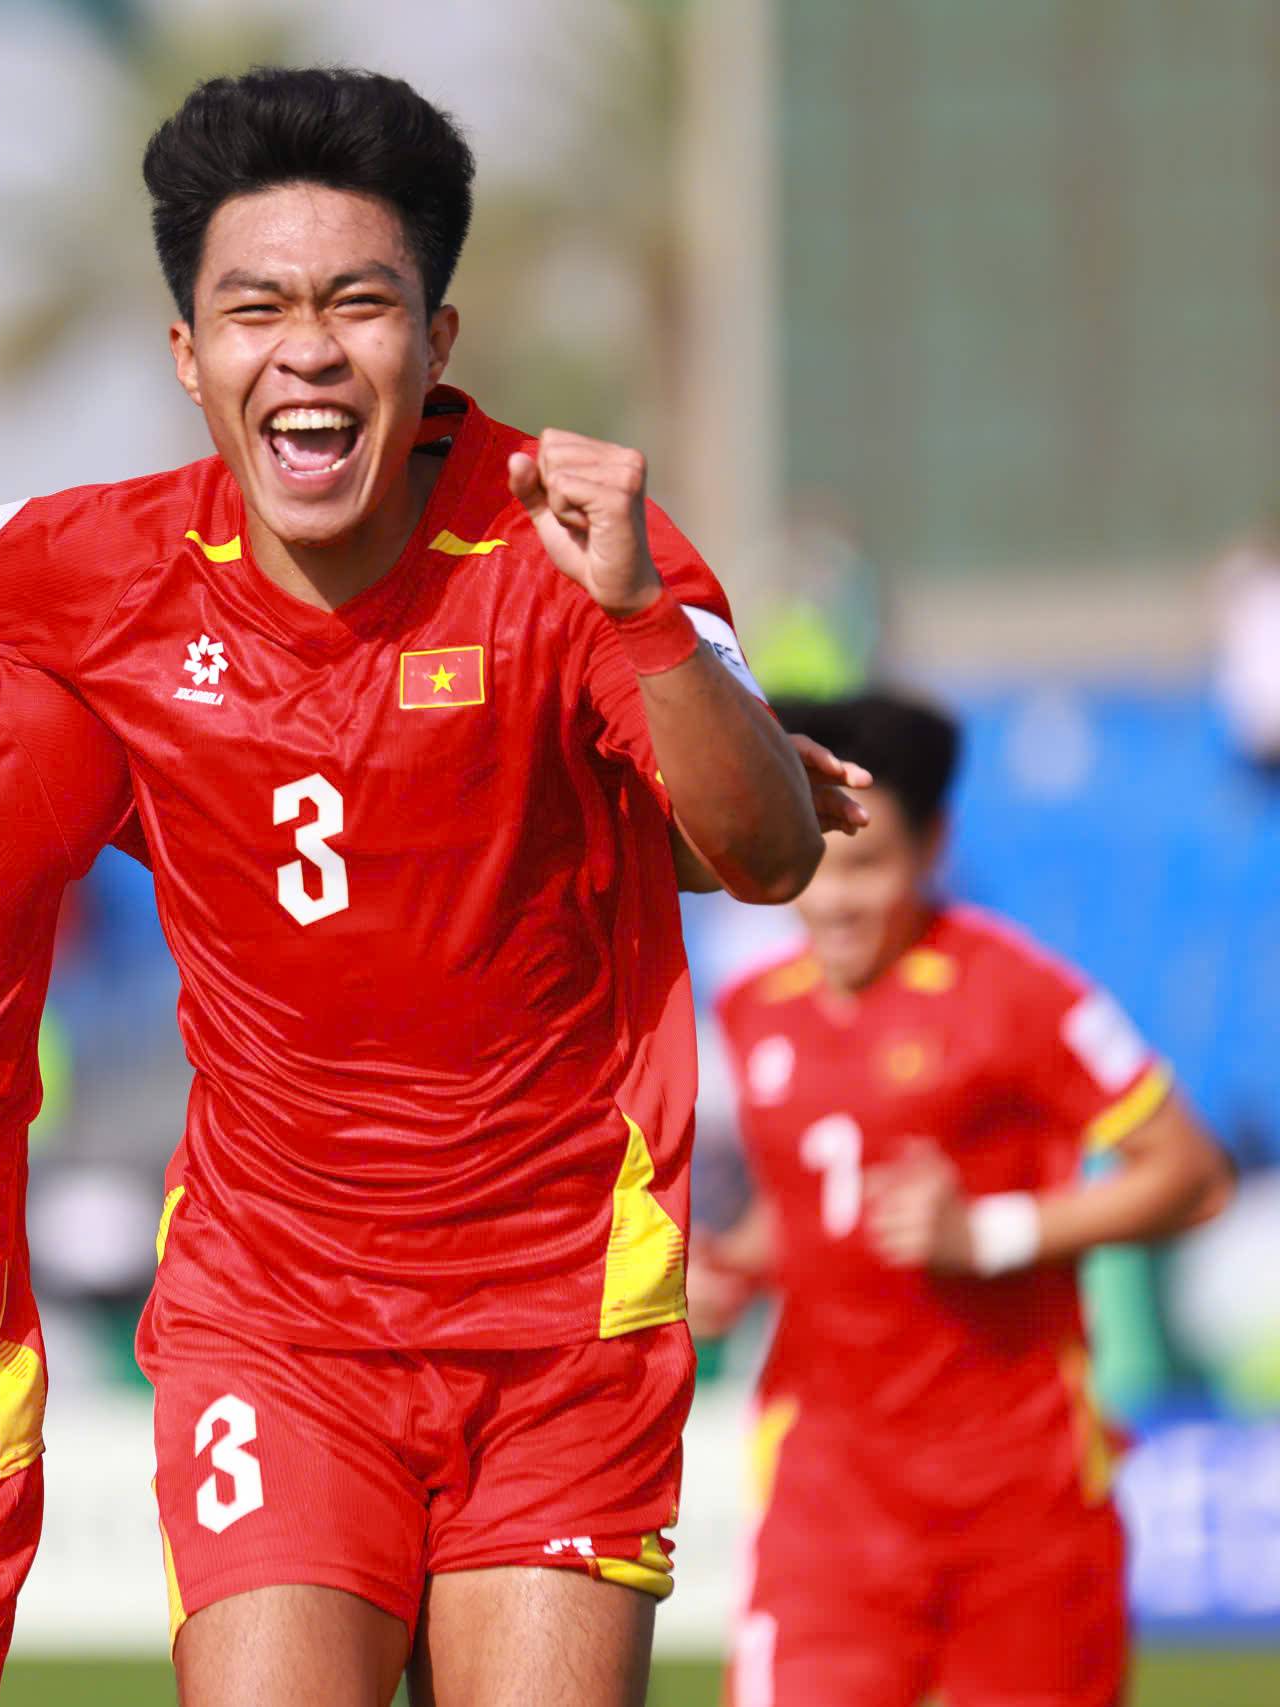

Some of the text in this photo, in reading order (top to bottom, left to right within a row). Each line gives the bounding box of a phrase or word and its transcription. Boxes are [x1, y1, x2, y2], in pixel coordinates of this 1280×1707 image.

[272, 772, 350, 927] 3
[798, 1112, 863, 1240] 1
[194, 1393, 264, 1535] 3
